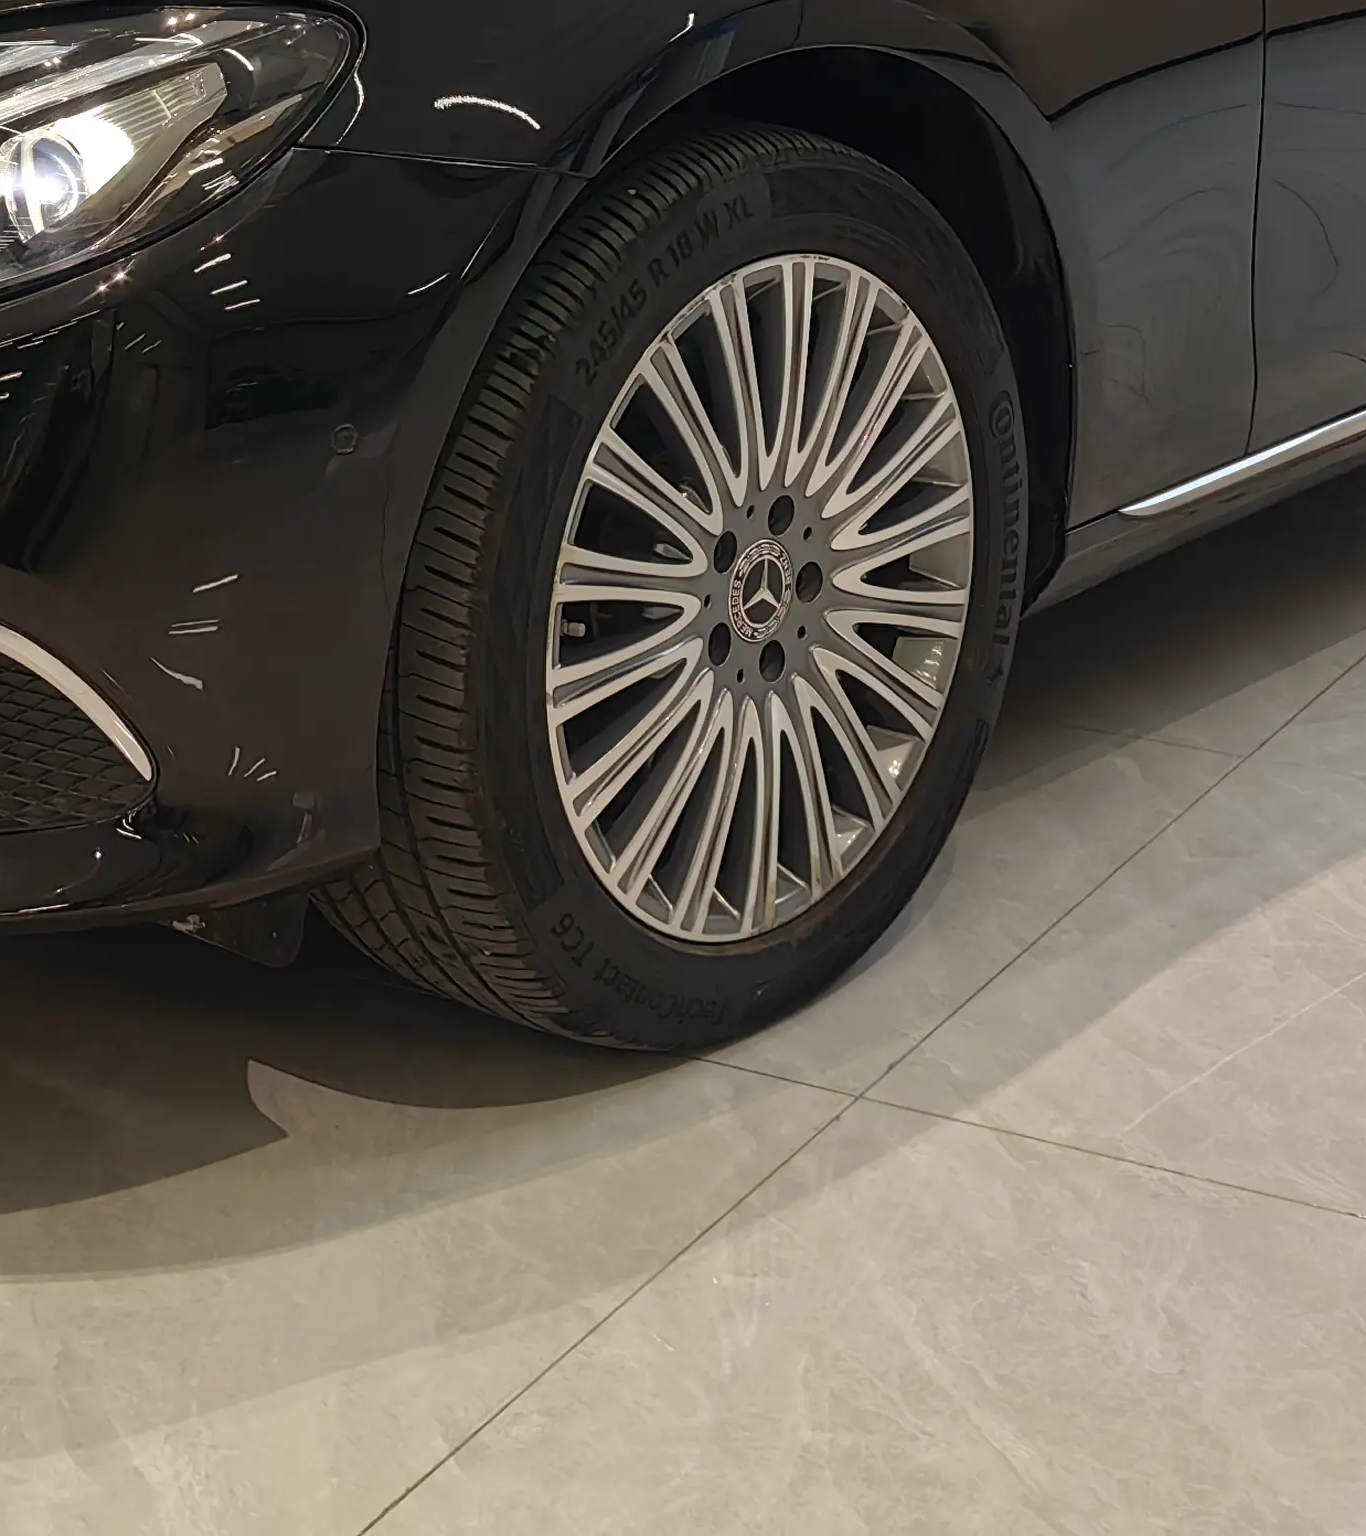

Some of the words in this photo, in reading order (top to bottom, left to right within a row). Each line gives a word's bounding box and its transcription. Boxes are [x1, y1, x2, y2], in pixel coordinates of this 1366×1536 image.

[989, 389, 1021, 646] Continental
[731, 579, 754, 638] MERCEDES
[549, 912, 595, 969] TC6
